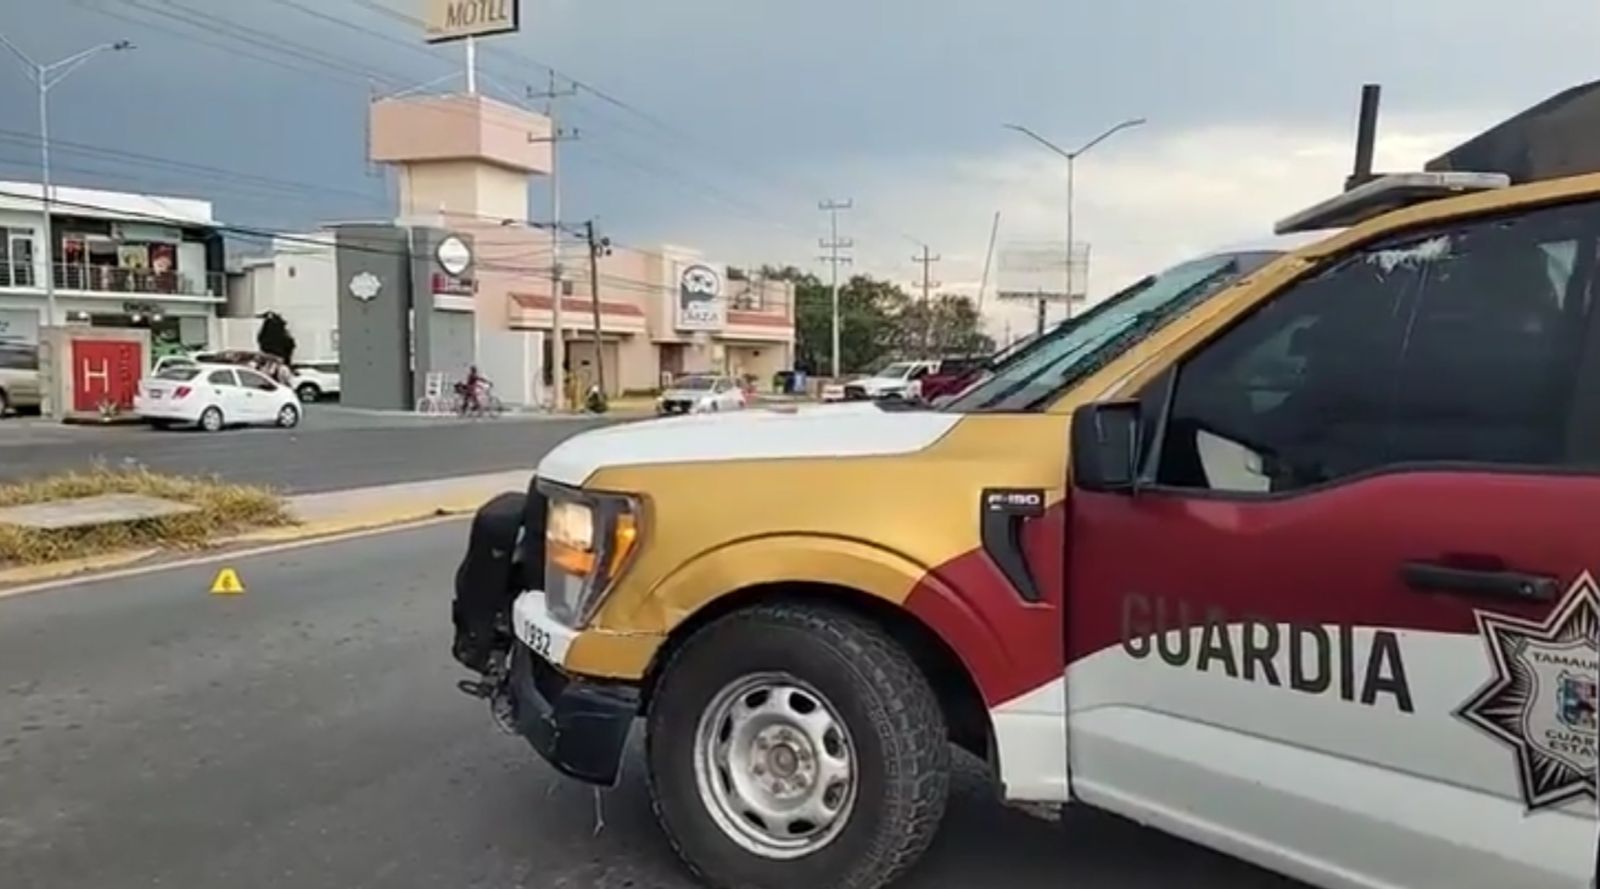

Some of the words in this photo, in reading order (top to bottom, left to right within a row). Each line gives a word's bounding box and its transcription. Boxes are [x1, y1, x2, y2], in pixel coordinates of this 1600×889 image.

[83, 357, 109, 393] H
[524, 620, 550, 656] 1932
[1121, 593, 1415, 714] GUARDIA
